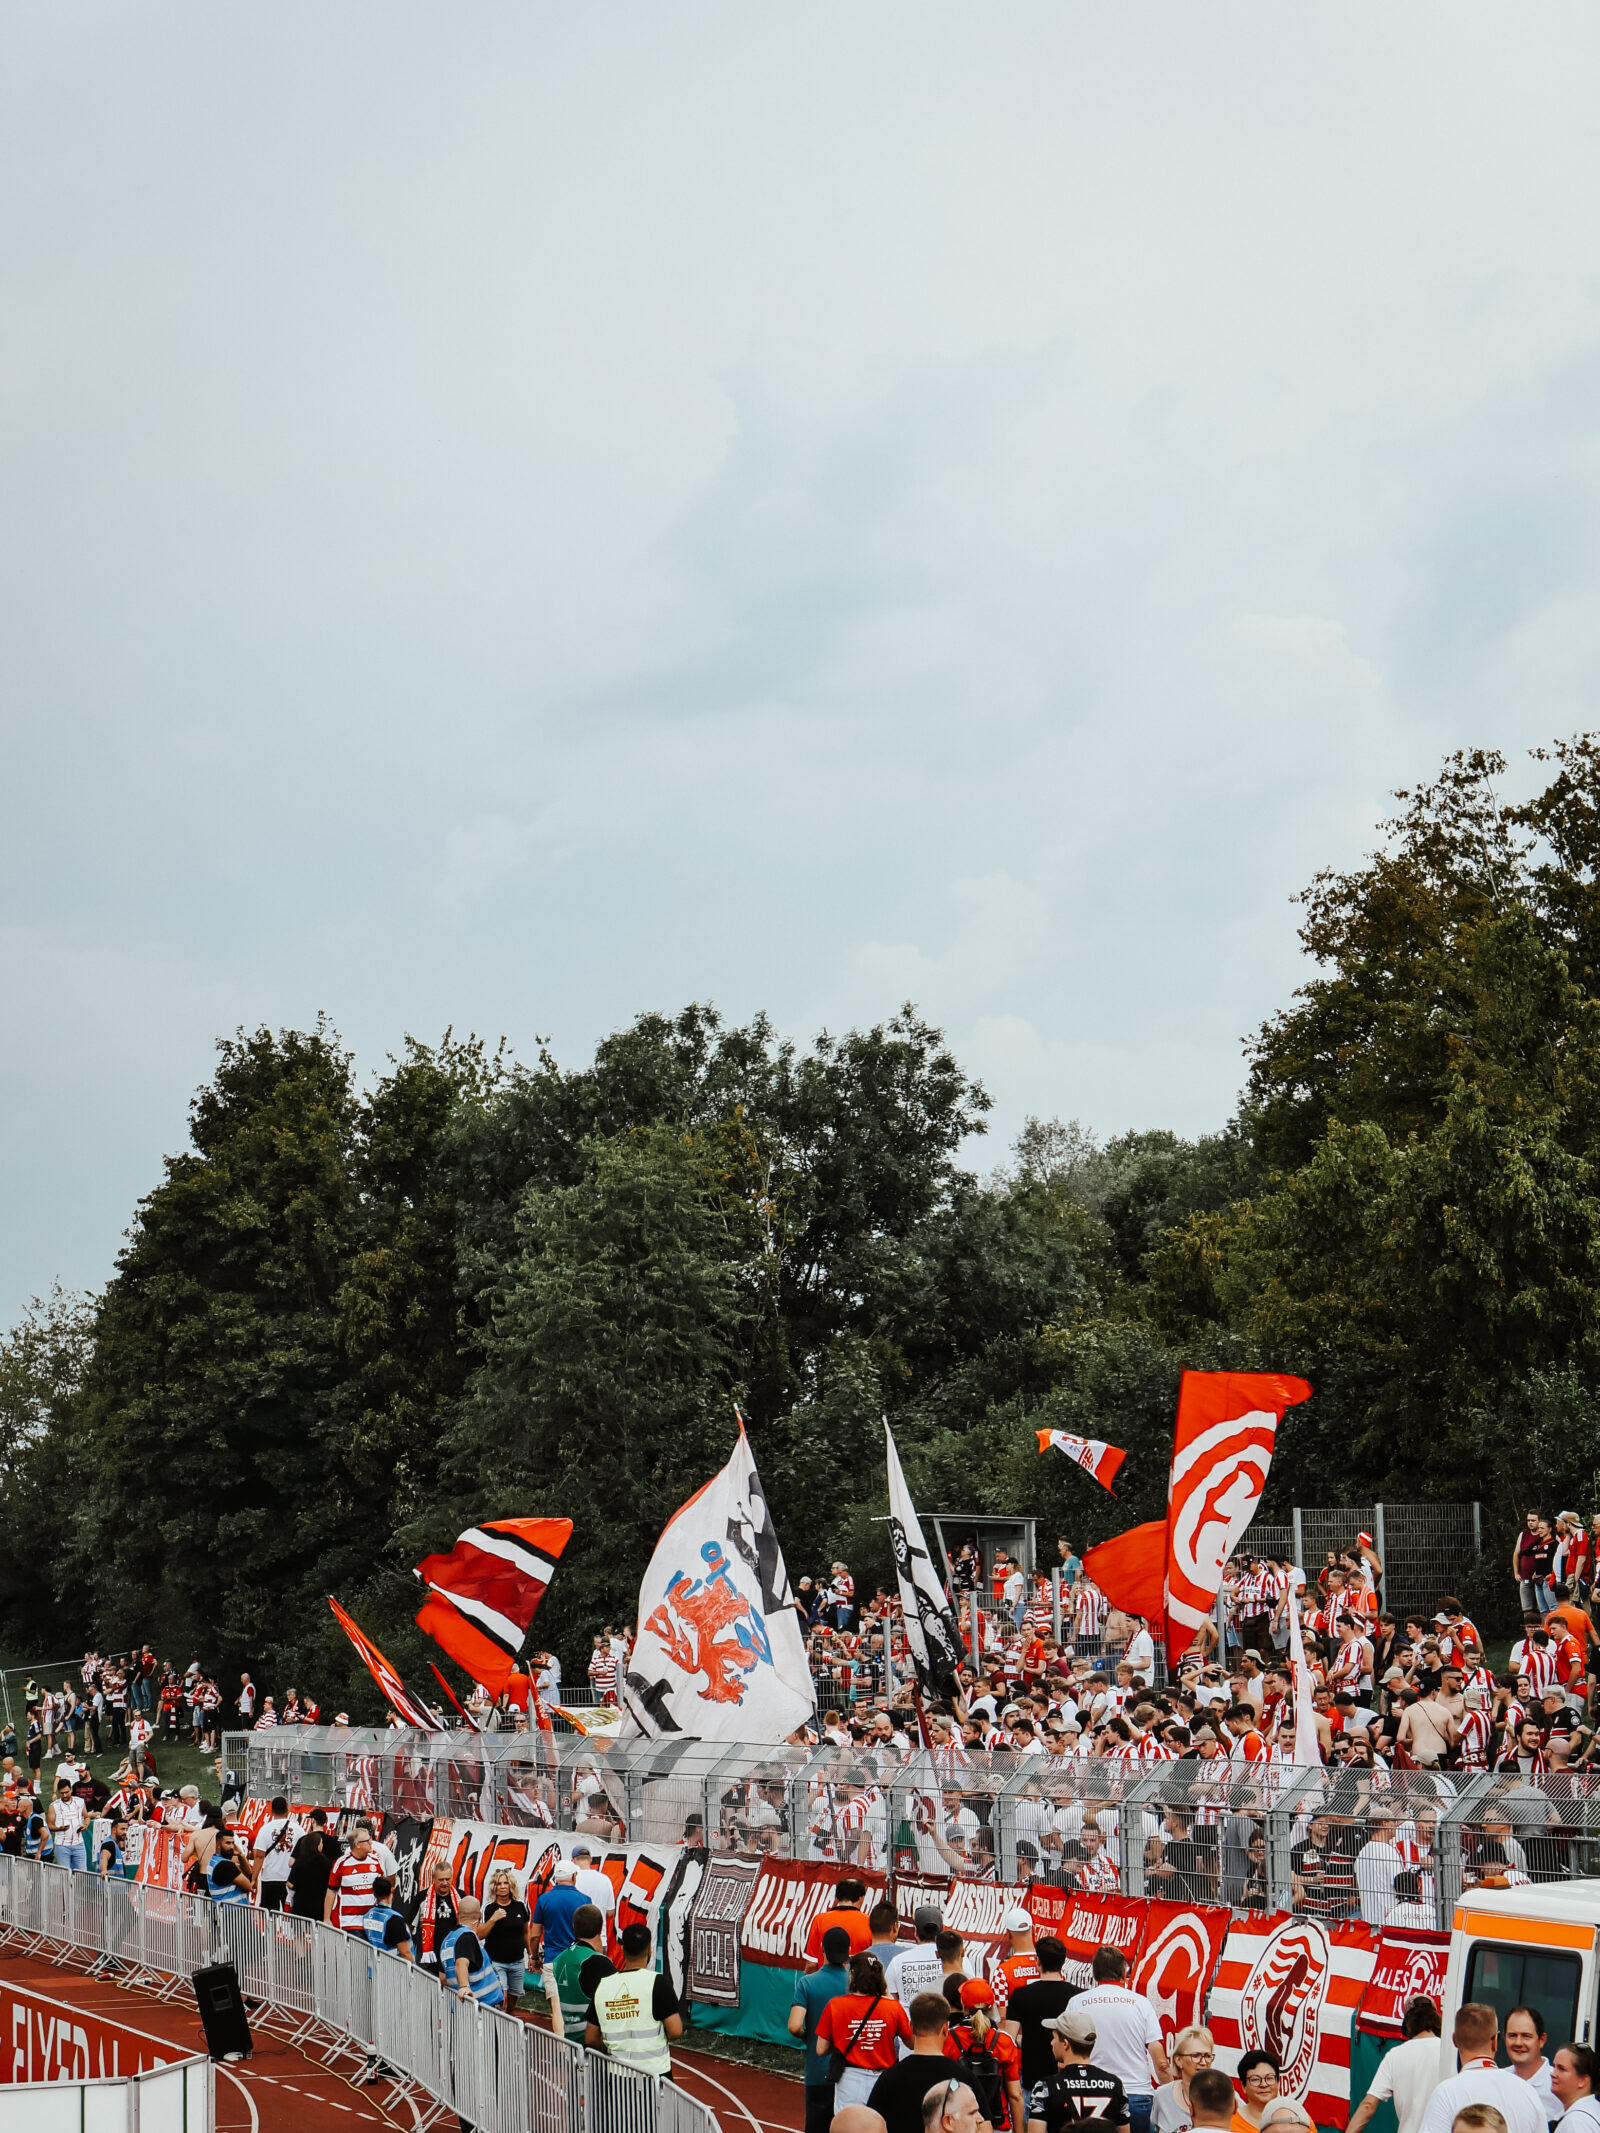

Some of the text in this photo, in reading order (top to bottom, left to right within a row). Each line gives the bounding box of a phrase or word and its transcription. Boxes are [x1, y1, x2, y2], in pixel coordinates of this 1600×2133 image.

[1066, 1901, 1105, 1945] ÜBERALL
[1101, 1913, 1139, 1948] BULLEN
[696, 1929, 731, 1979] IDEALE
[1013, 1965, 1039, 1978] DÜSSEL
[1372, 1966, 1410, 1993] ALLES
[12, 2003, 168, 2083] FLYER
[1056, 2078, 1116, 2091] SSELDORF
